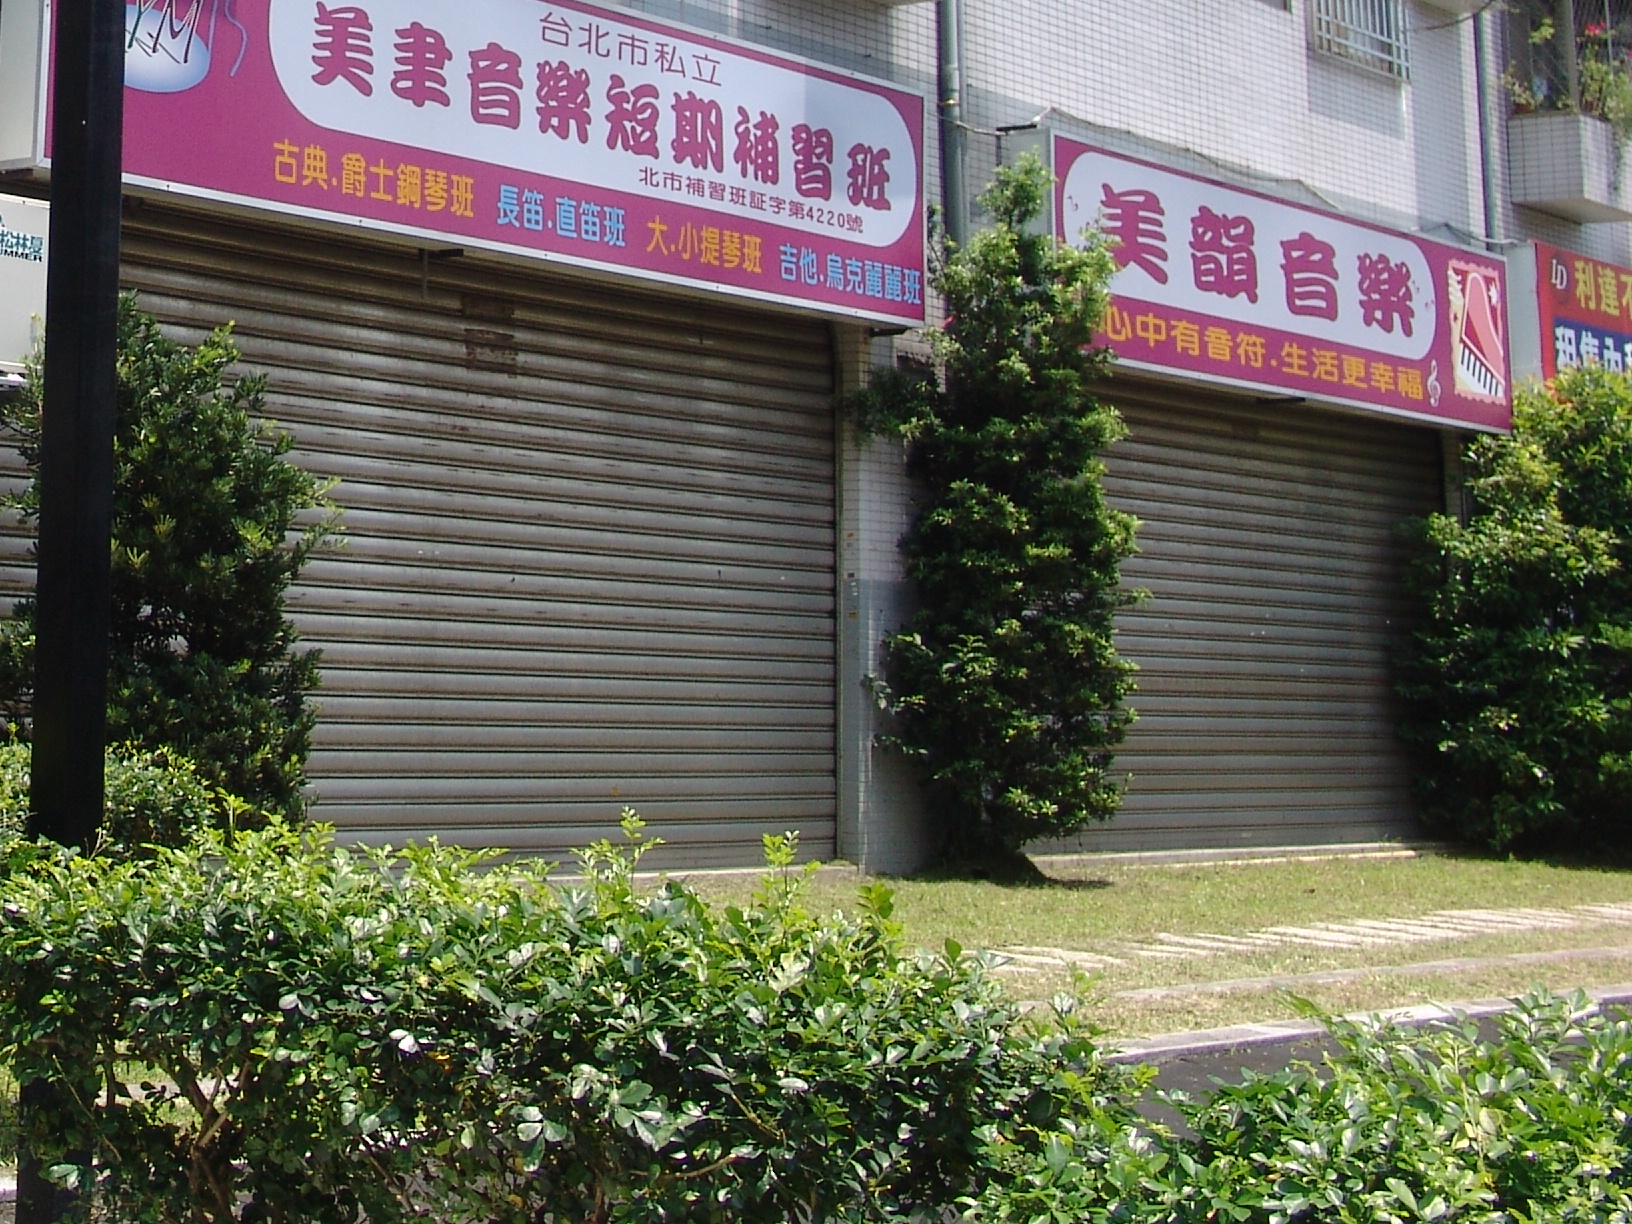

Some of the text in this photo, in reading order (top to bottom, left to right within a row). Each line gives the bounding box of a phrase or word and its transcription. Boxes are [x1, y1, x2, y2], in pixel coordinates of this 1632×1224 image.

[311, 1, 891, 210] 美聿音樂短期補習班
[539, 11, 722, 87] 台北市私立
[639, 166, 864, 233] 北市補習班証字第4220號
[1099, 182, 1416, 338] 美韻音樂
